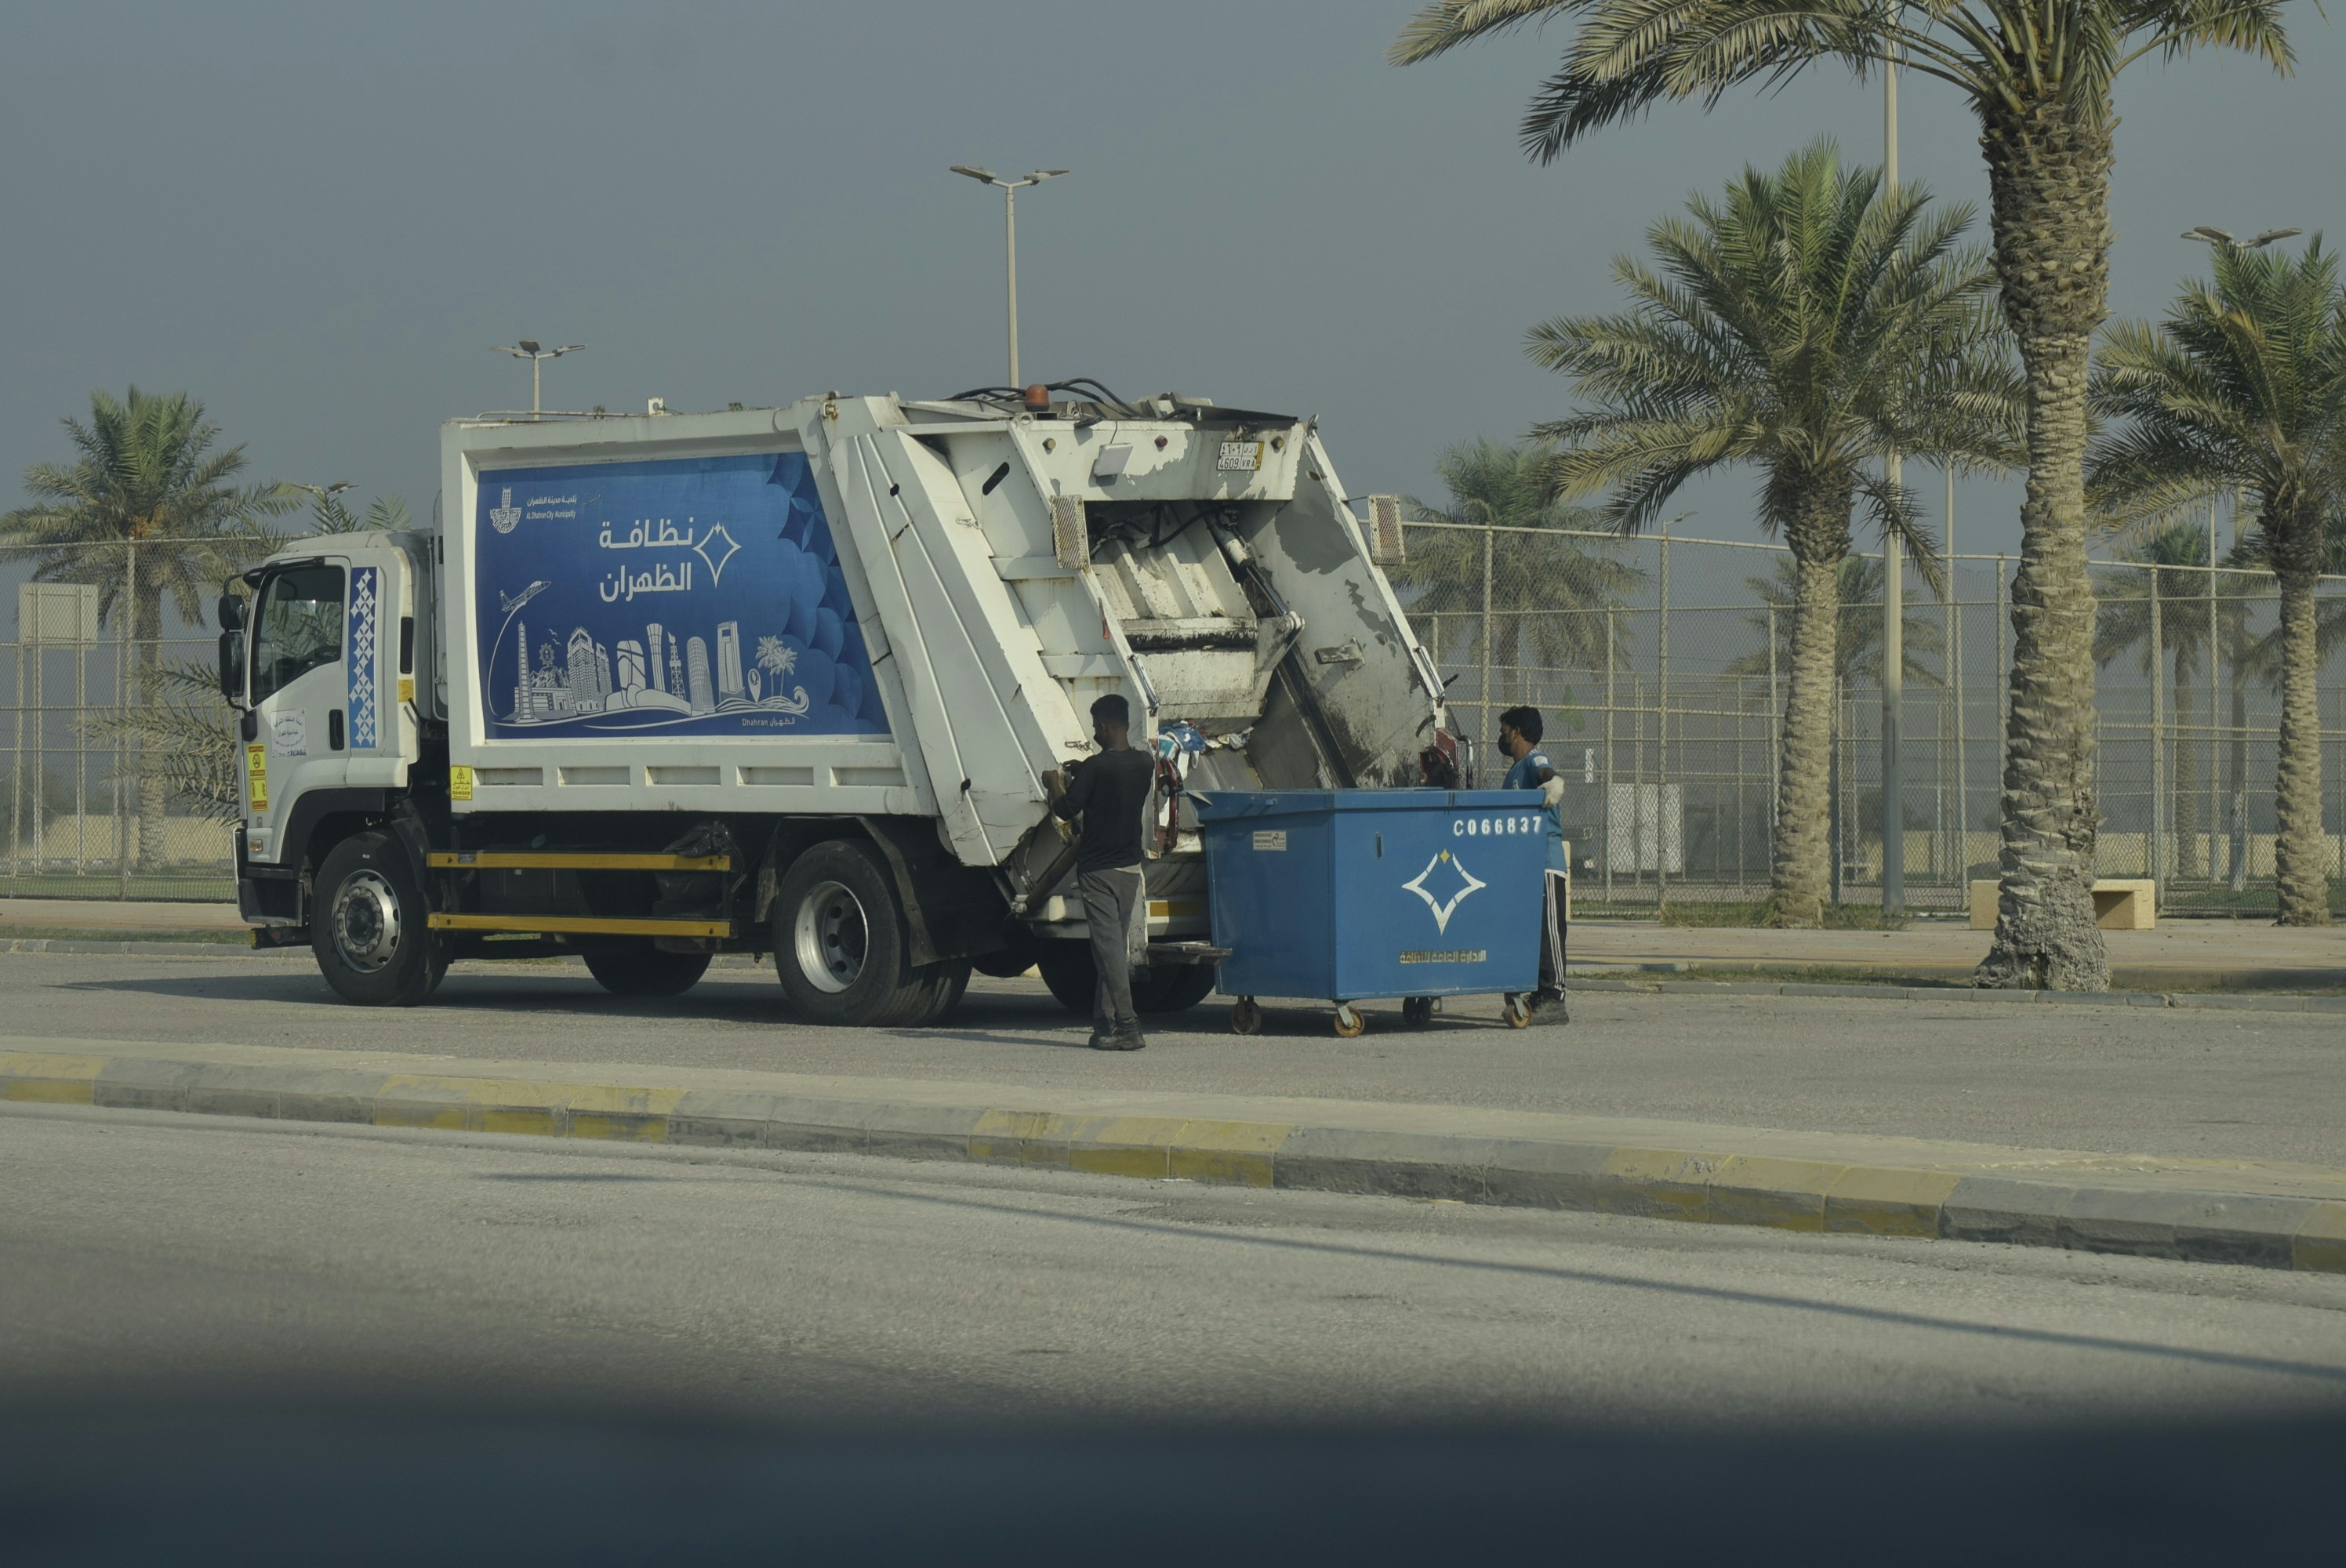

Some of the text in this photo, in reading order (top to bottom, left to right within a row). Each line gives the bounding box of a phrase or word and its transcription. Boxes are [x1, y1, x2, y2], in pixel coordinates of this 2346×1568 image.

[1219, 458, 1255, 469] 4609 VRA
[526, 495, 577, 506] بلدية مدينة الظهران
[532, 511, 547, 520] Dhahran
[555, 510, 576, 519] Municipality
[599, 517, 694, 549] نظافة
[600, 562, 692, 602] الظهران
[742, 718, 768, 727] Dhahran
[769, 717, 796, 727] الظهران
[1454, 815, 1542, 837] C066837
